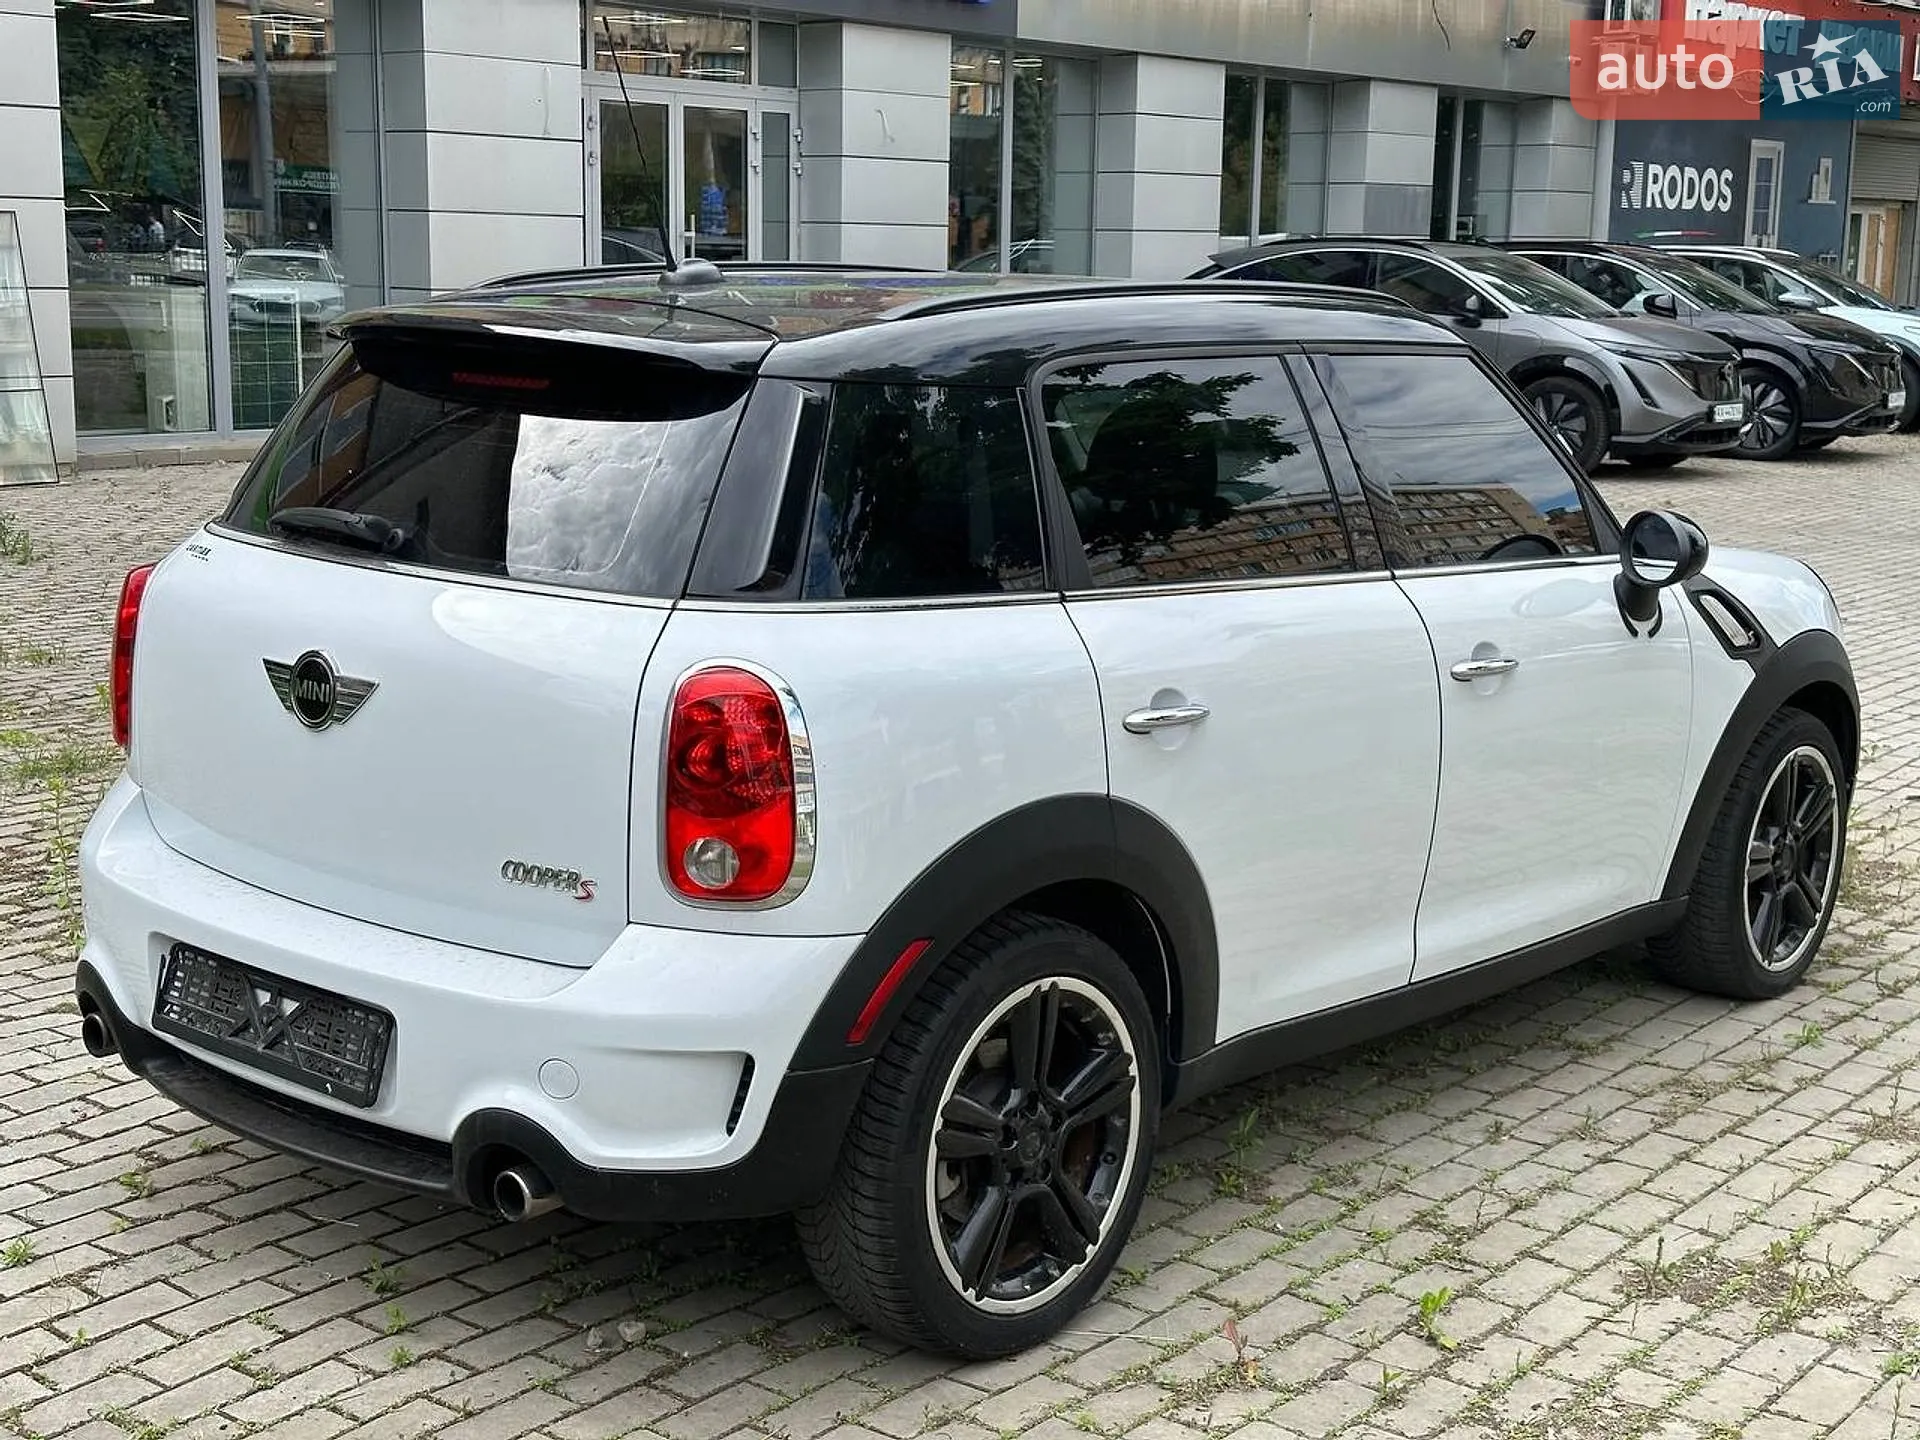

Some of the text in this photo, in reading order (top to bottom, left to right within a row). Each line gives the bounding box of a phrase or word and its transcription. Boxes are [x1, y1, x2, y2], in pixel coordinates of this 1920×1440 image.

[1646, 163, 1734, 212] RODOS
[295, 679, 330, 703] MINI
[501, 859, 581, 894] COOPER
